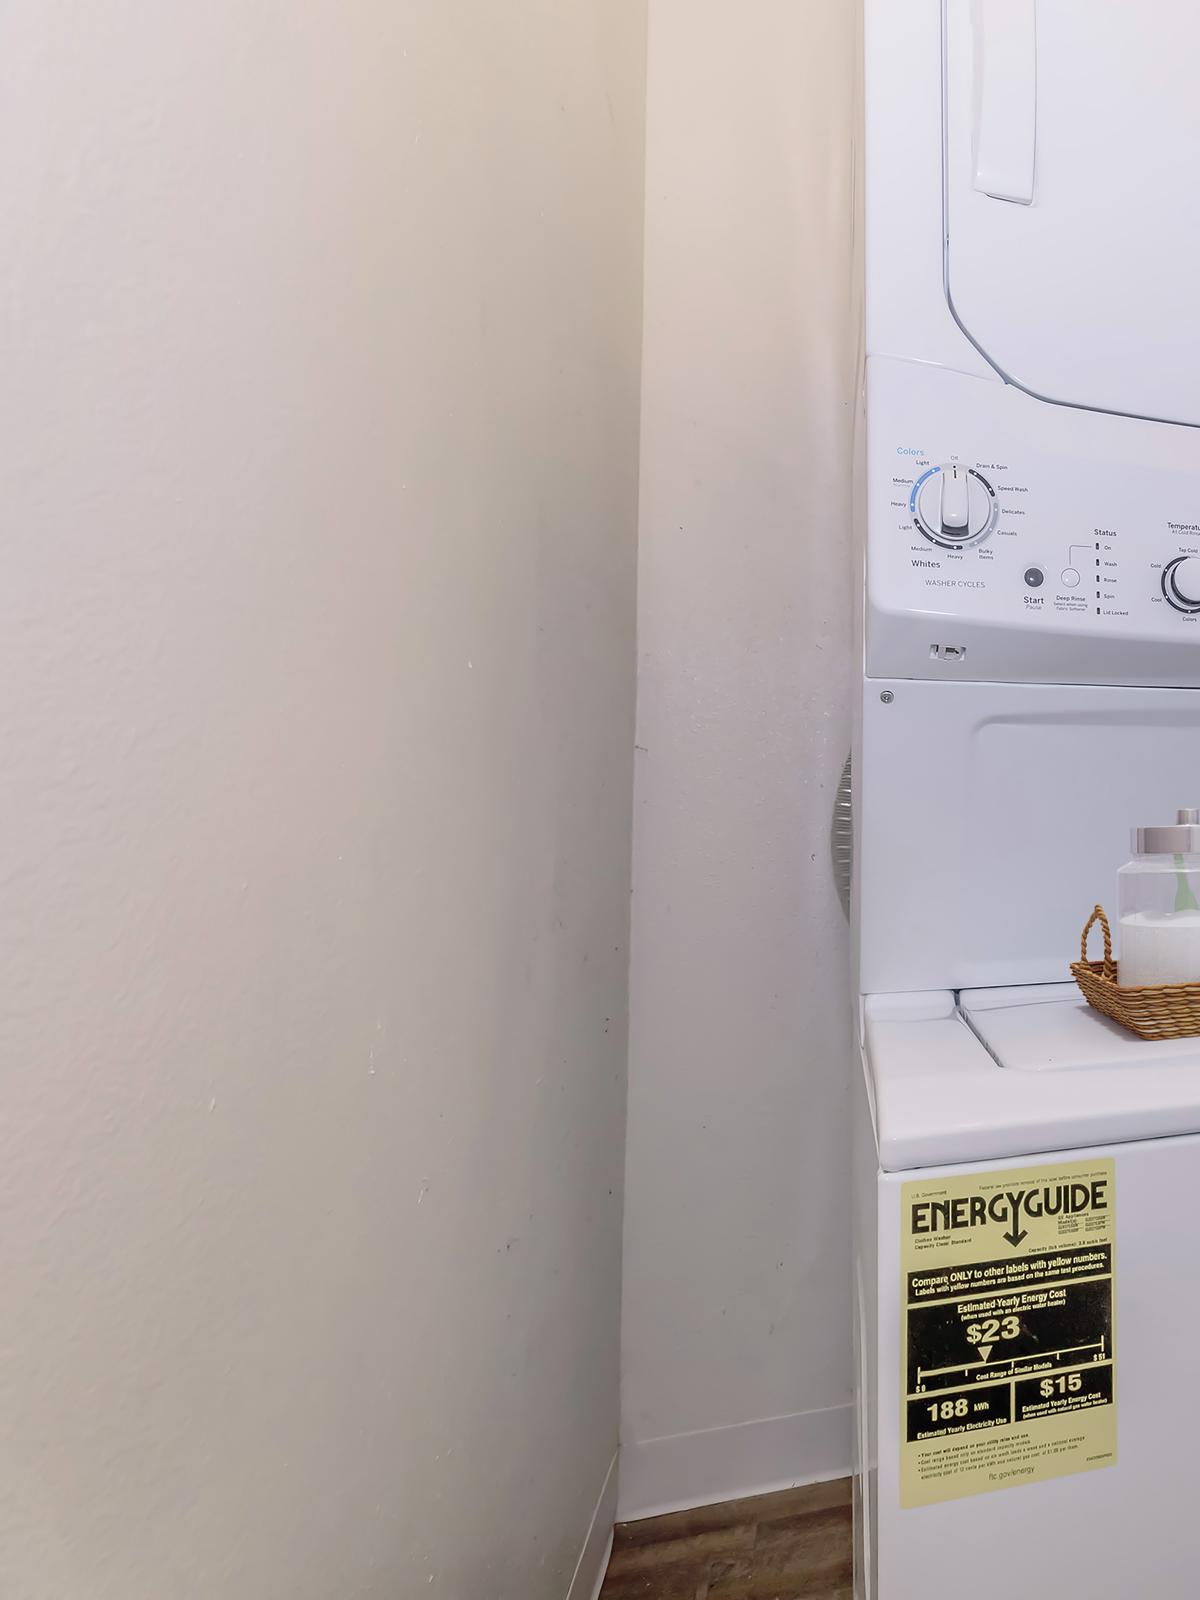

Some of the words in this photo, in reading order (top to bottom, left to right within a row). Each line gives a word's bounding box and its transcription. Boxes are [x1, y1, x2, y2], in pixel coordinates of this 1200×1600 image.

[897, 447, 924, 456] Colors
[1094, 528, 1117, 536] Status
[912, 560, 940, 568] Whites
[912, 1180, 1107, 1236] ENERGYGUIDE
[912, 1275, 948, 1287] Compare
[950, 1270, 972, 1281] ONLY
[974, 1270, 982, 1278] to
[984, 1267, 1004, 1276] other
[1006, 1262, 1029, 1274] labels
[1030, 1260, 1047, 1270] with
[1048, 1257, 1072, 1269] yellow
[1073, 1252, 1107, 1264] numbers.
[915, 1286, 935, 1296] Labels
[950, 1284, 970, 1292] yellow
[970, 1279, 996, 1288] numbers
[1008, 1274, 1024, 1282] based
[1072, 1262, 1104, 1274] procedures.
[957, 1300, 996, 1314] Estimated
[997, 1296, 1020, 1307] Yearly
[1022, 1292, 1048, 1304] Energy
[1049, 1289, 1066, 1298] Cost
[961, 1313, 977, 1322] (when
[1013, 1304, 1031, 1313] electric
[966, 1316, 1020, 1344] $23
[990, 1370, 1007, 1379] Range
[1034, 1362, 1052, 1370] Models
[1040, 1374, 1082, 1398] $15
[927, 1399, 968, 1421] 188
[974, 1402, 990, 1412] kWh
[1022, 1402, 1050, 1413] Estimated
[1068, 1396, 1087, 1404] Energy
[917, 1428, 946, 1439] Estimated
[966, 1420, 995, 1430] Electricity
[989, 1466, 1034, 1480] ftc.gov/energy
